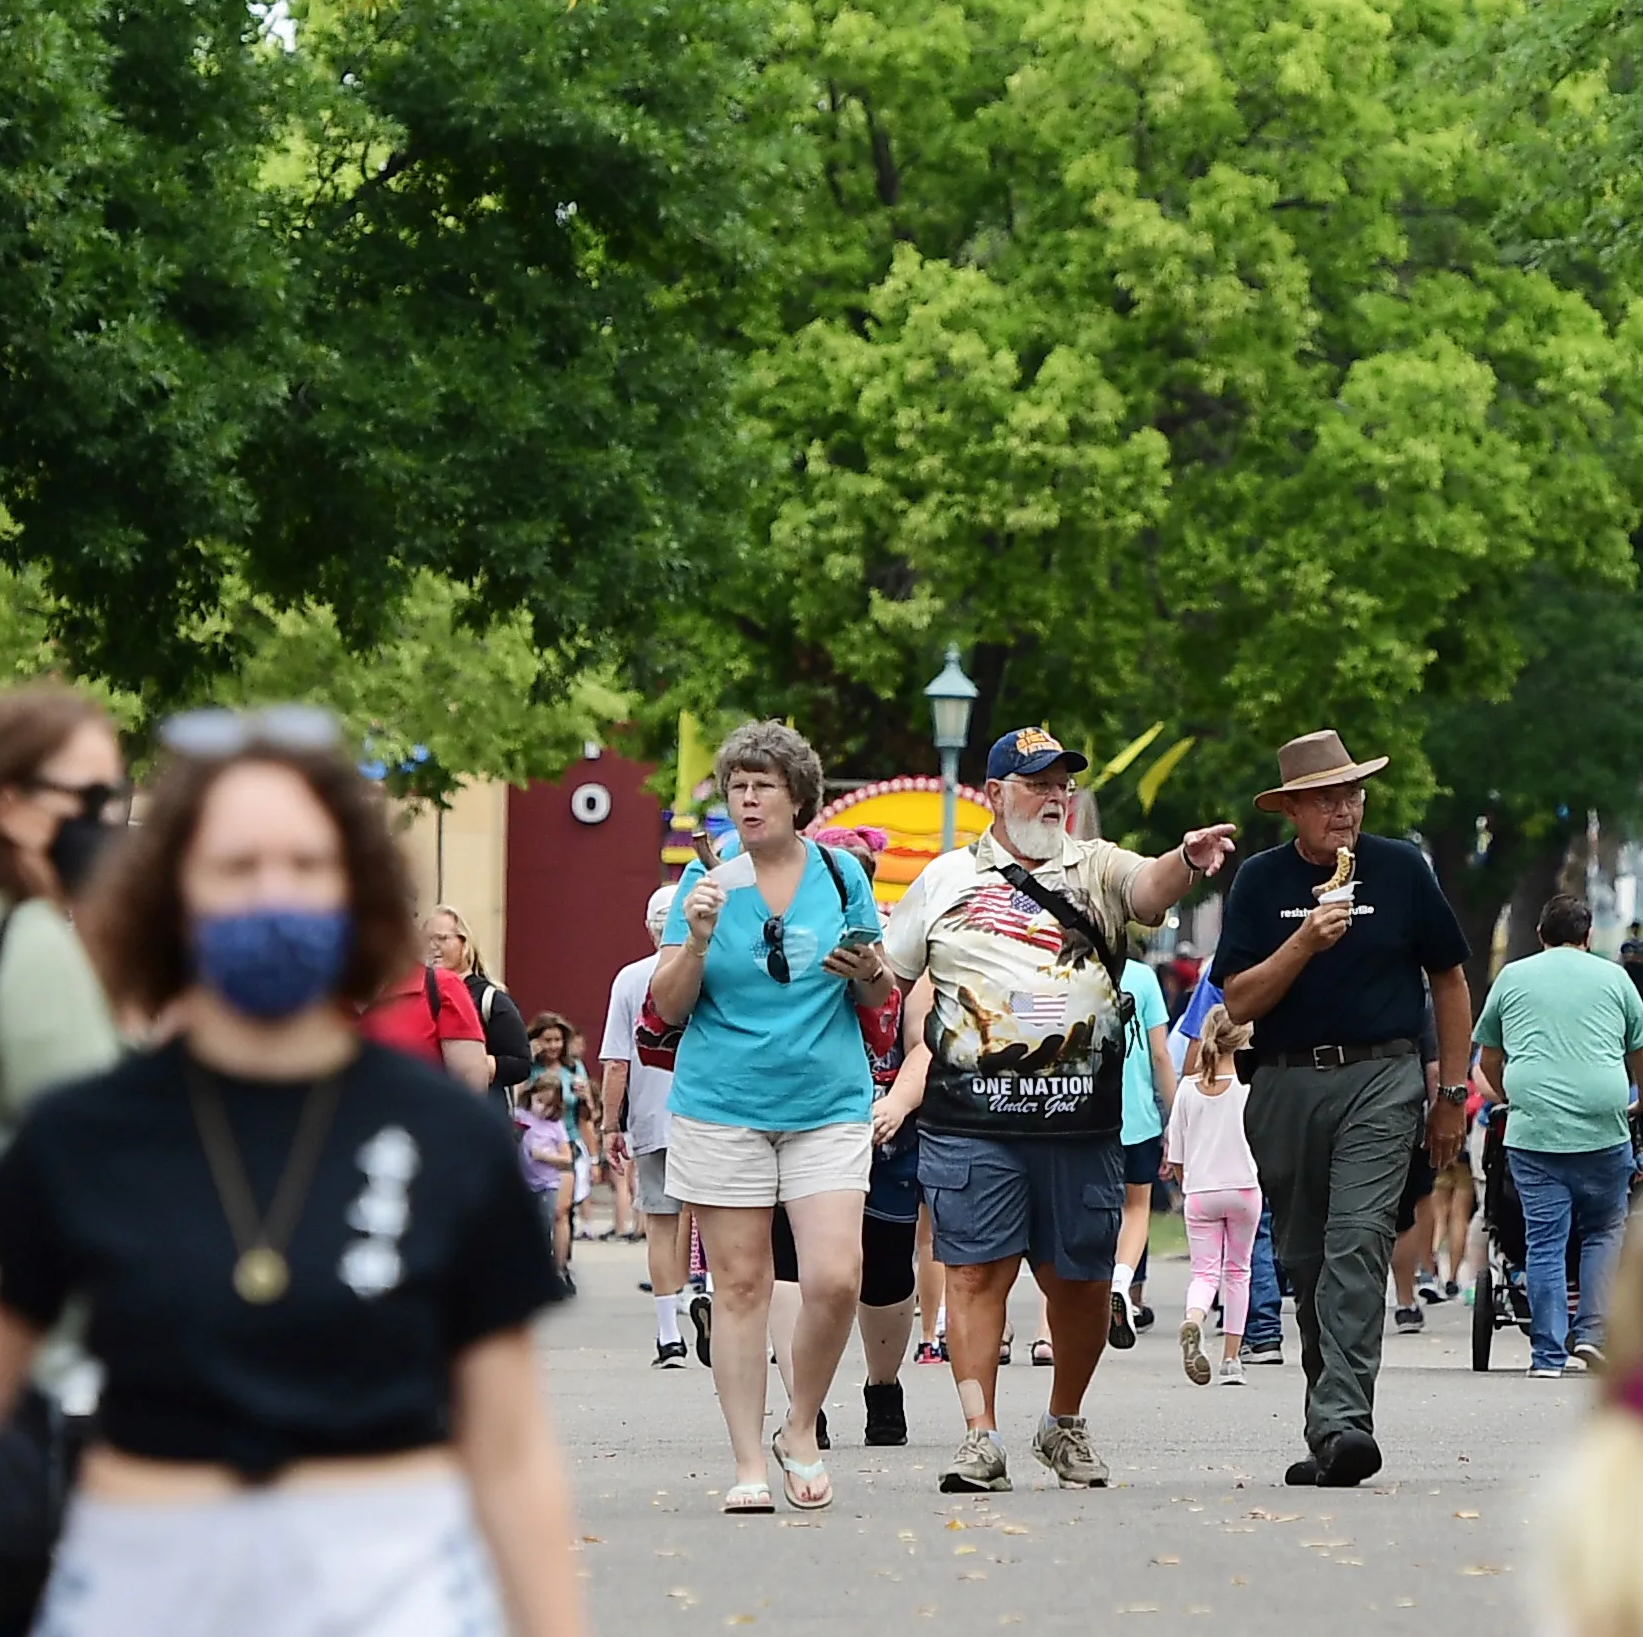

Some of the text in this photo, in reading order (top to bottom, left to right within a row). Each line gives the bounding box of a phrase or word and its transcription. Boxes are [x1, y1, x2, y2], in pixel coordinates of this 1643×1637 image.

[972, 1076, 1093, 1095] ONE NATION
[989, 1094, 1080, 1119] Under God
